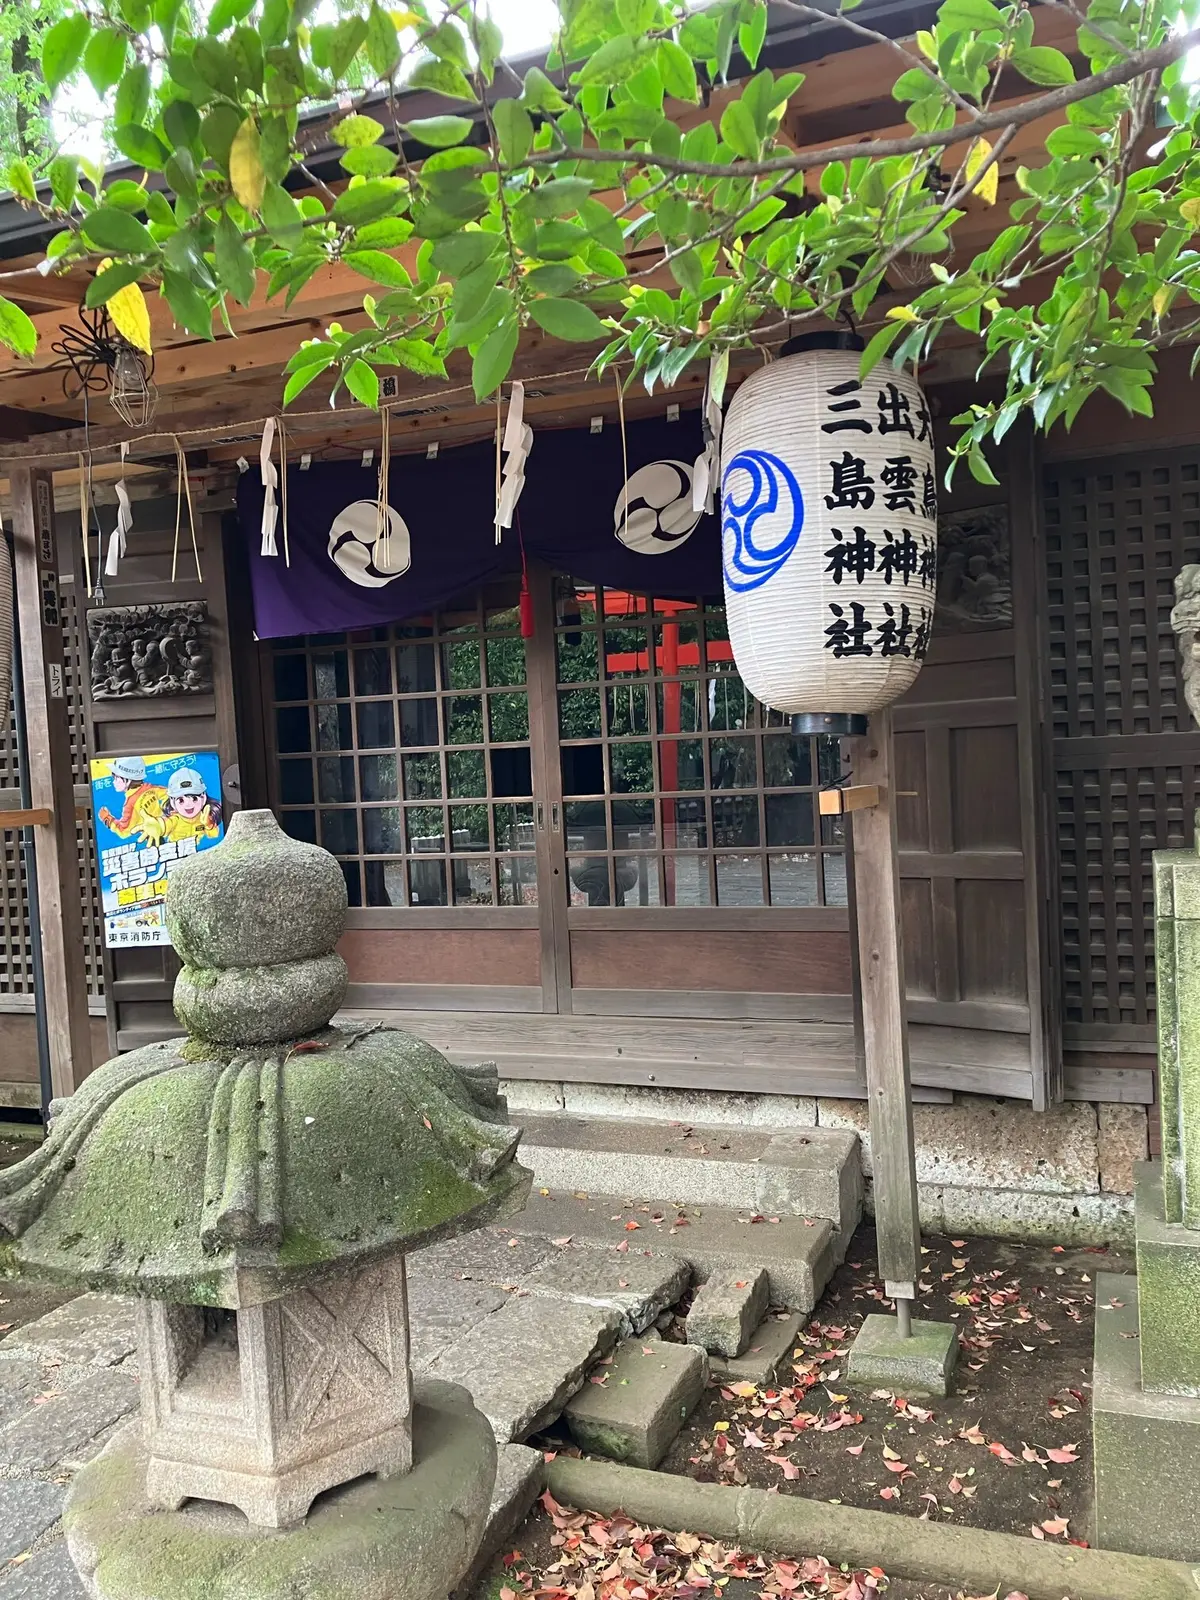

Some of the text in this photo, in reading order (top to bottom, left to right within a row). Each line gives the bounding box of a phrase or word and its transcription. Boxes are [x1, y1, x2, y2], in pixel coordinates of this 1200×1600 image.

[821, 380, 876, 659] 三島神社
[874, 383, 919, 658] 出雲神社
[52, 666, 60, 696] トライ
[108, 931, 161, 943] 東京消防庁
